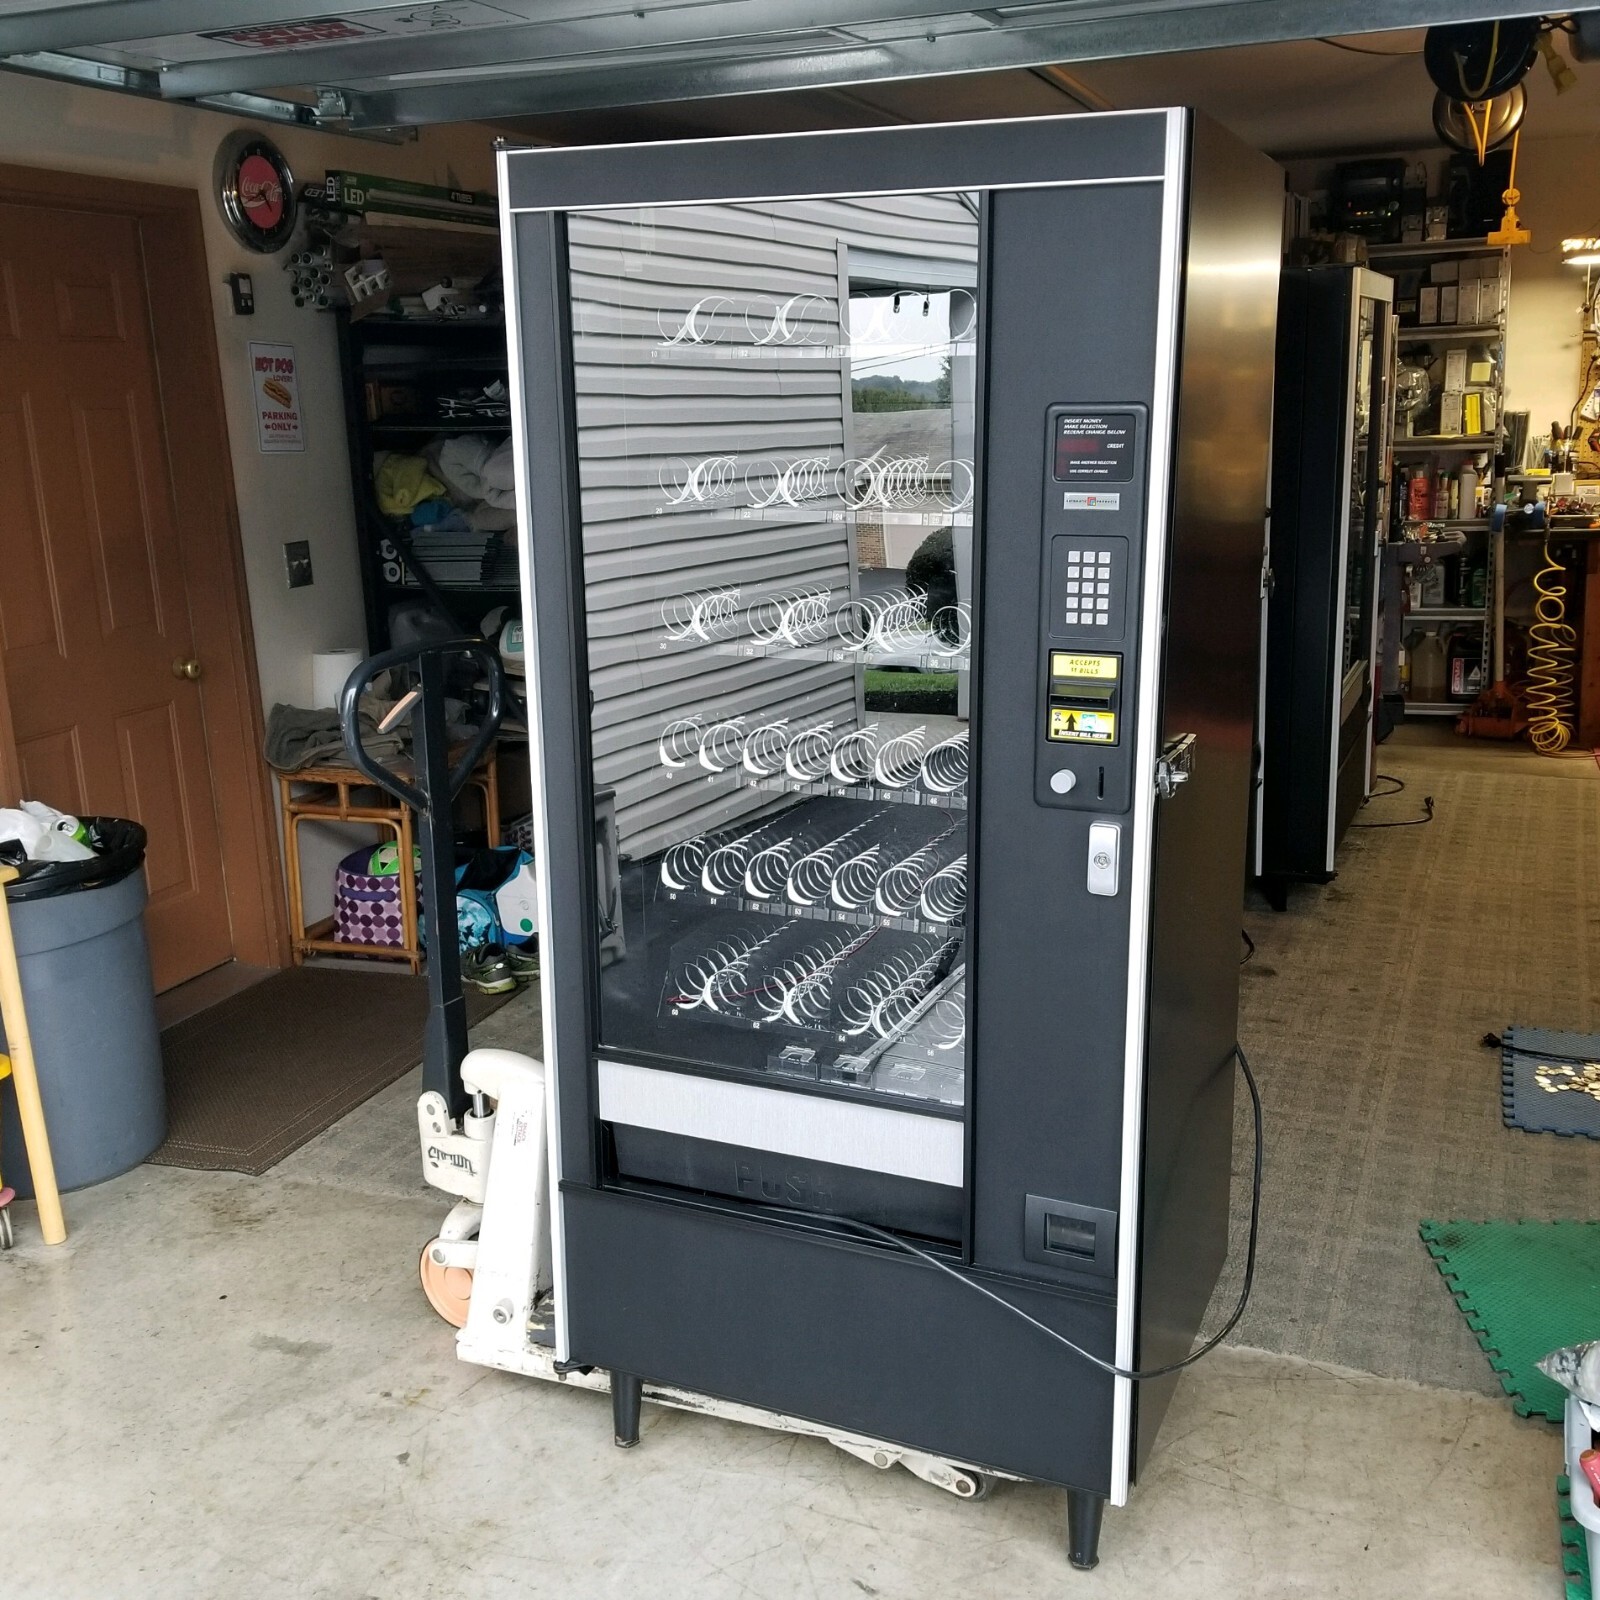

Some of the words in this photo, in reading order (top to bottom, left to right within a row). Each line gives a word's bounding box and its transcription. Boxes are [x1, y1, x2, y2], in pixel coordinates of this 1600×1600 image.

[241, 176, 283, 202] Coca-Cola
[326, 176, 336, 202] LED
[344, 187, 365, 205] LED
[255, 356, 274, 373] HOT
[275, 357, 294, 374] DOG
[262, 411, 298, 420] PARKING
[271, 422, 292, 431] ONLY
[1069, 659, 1101, 667] ACCEPTS
[1079, 667, 1099, 675] BILLS
[1058, 729, 1079, 737] INSERT
[837, 788, 845, 796] 44
[883, 792, 891, 800] 45
[930, 797, 938, 805] 46
[838, 913, 846, 921] 54
[734, 1160, 834, 1211] PUSH
